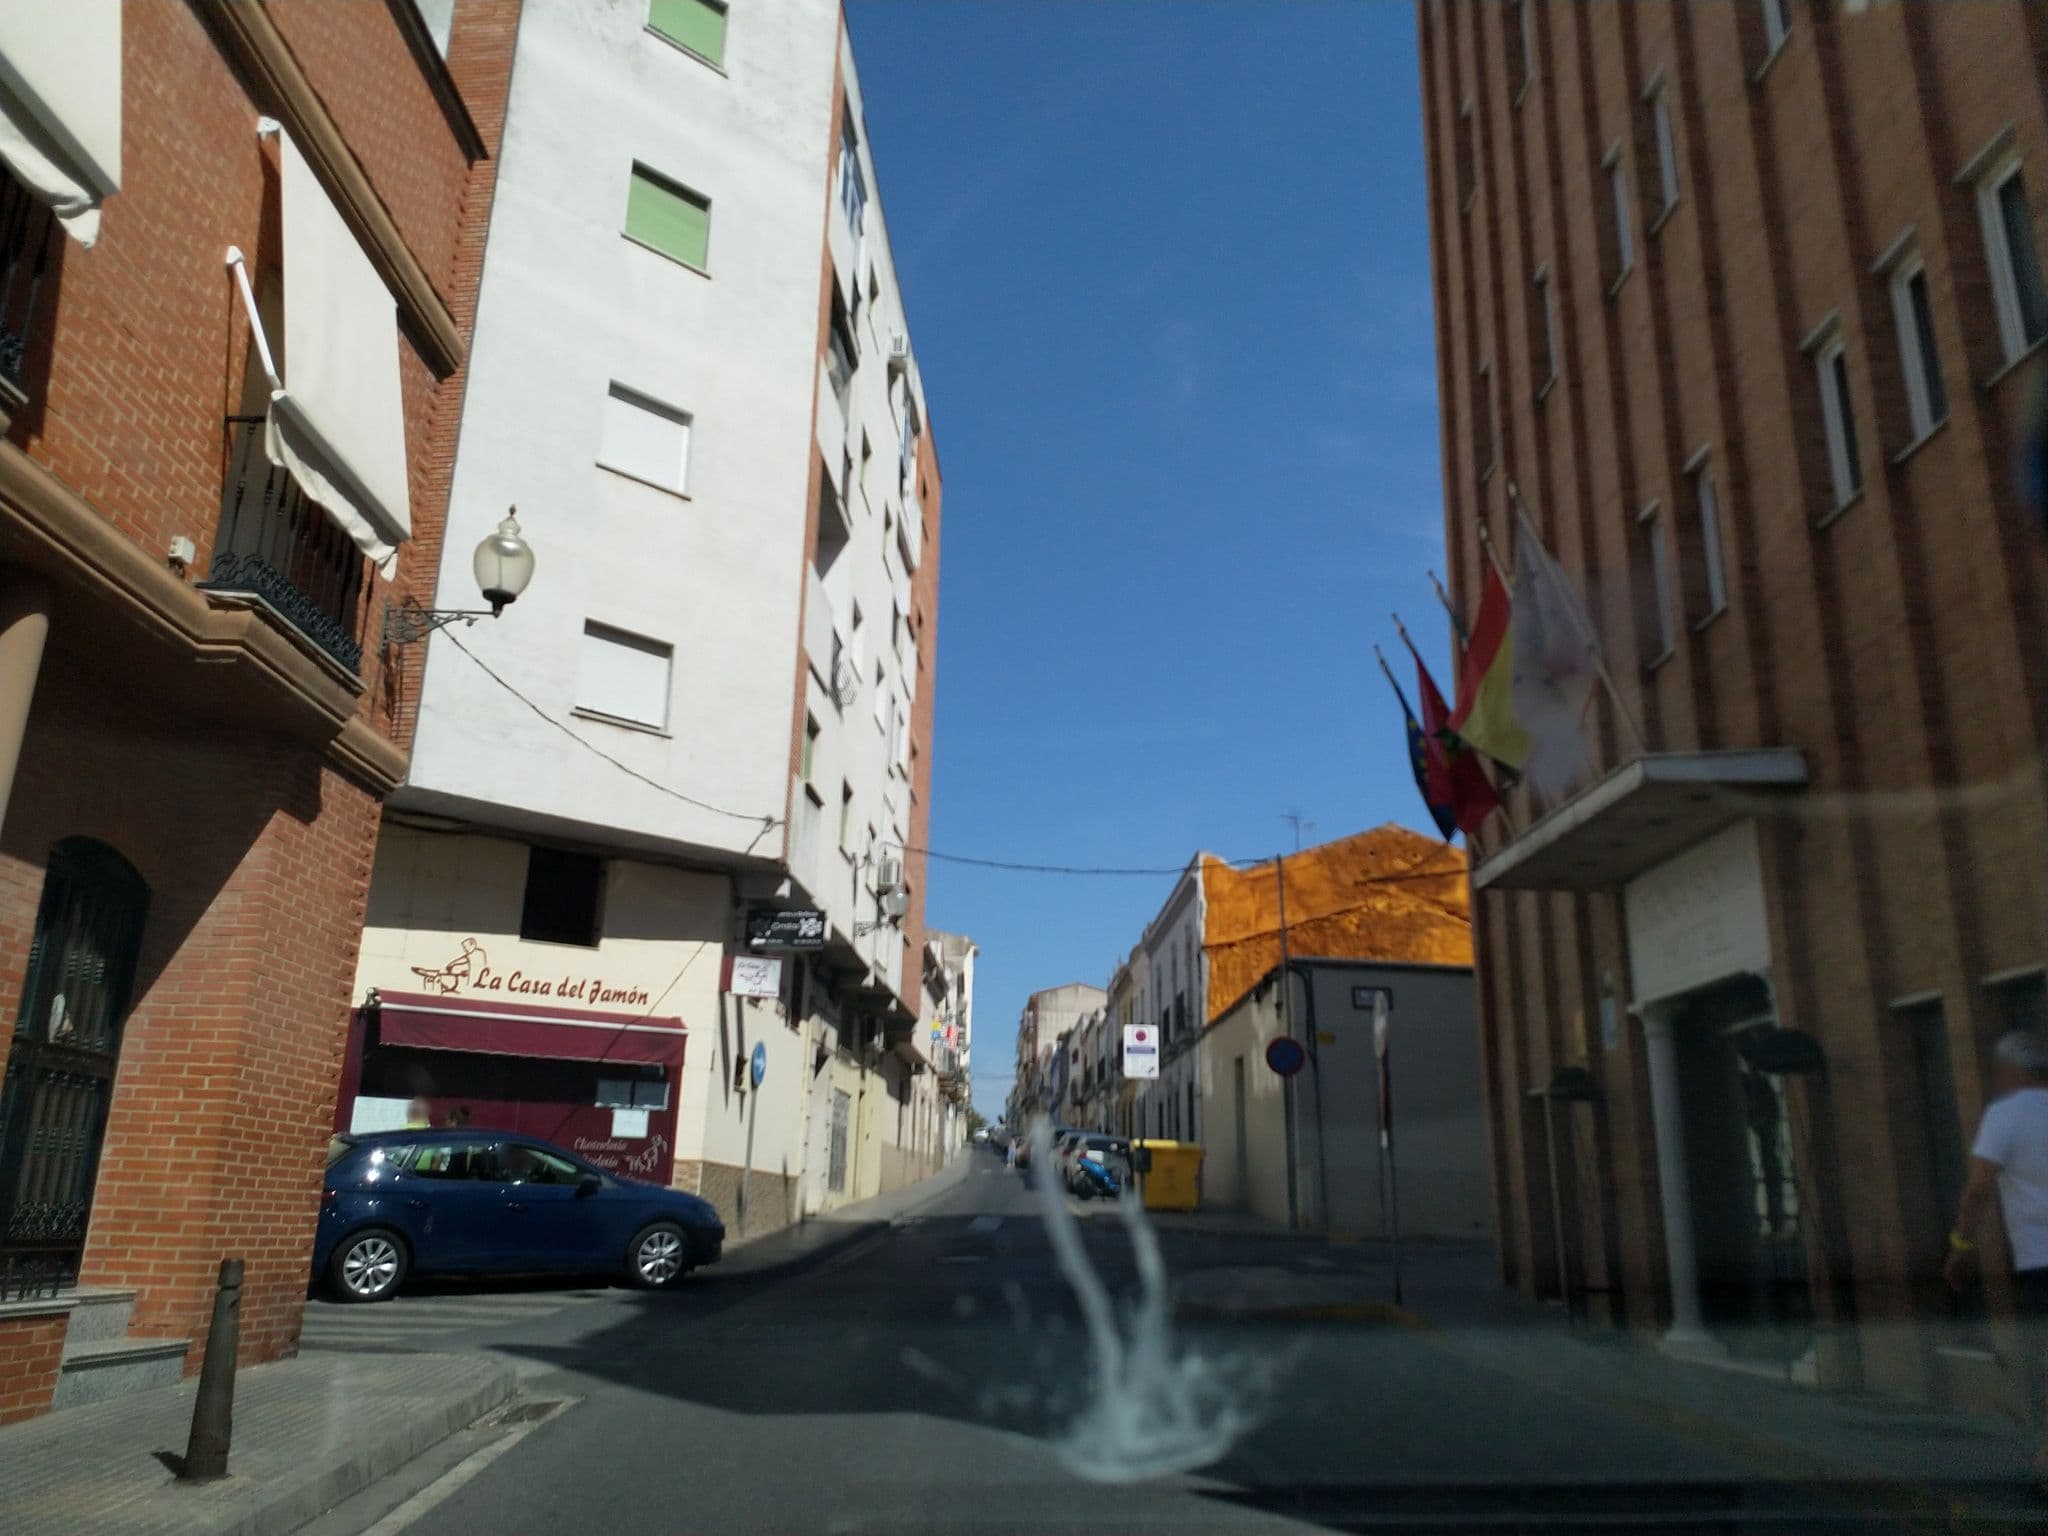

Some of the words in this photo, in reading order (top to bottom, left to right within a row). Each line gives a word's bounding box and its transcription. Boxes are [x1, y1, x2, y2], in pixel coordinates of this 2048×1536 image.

[473, 967, 502, 990] La
[508, 970, 552, 995] Casa
[557, 976, 586, 999] del
[589, 979, 649, 1005] Jamón
